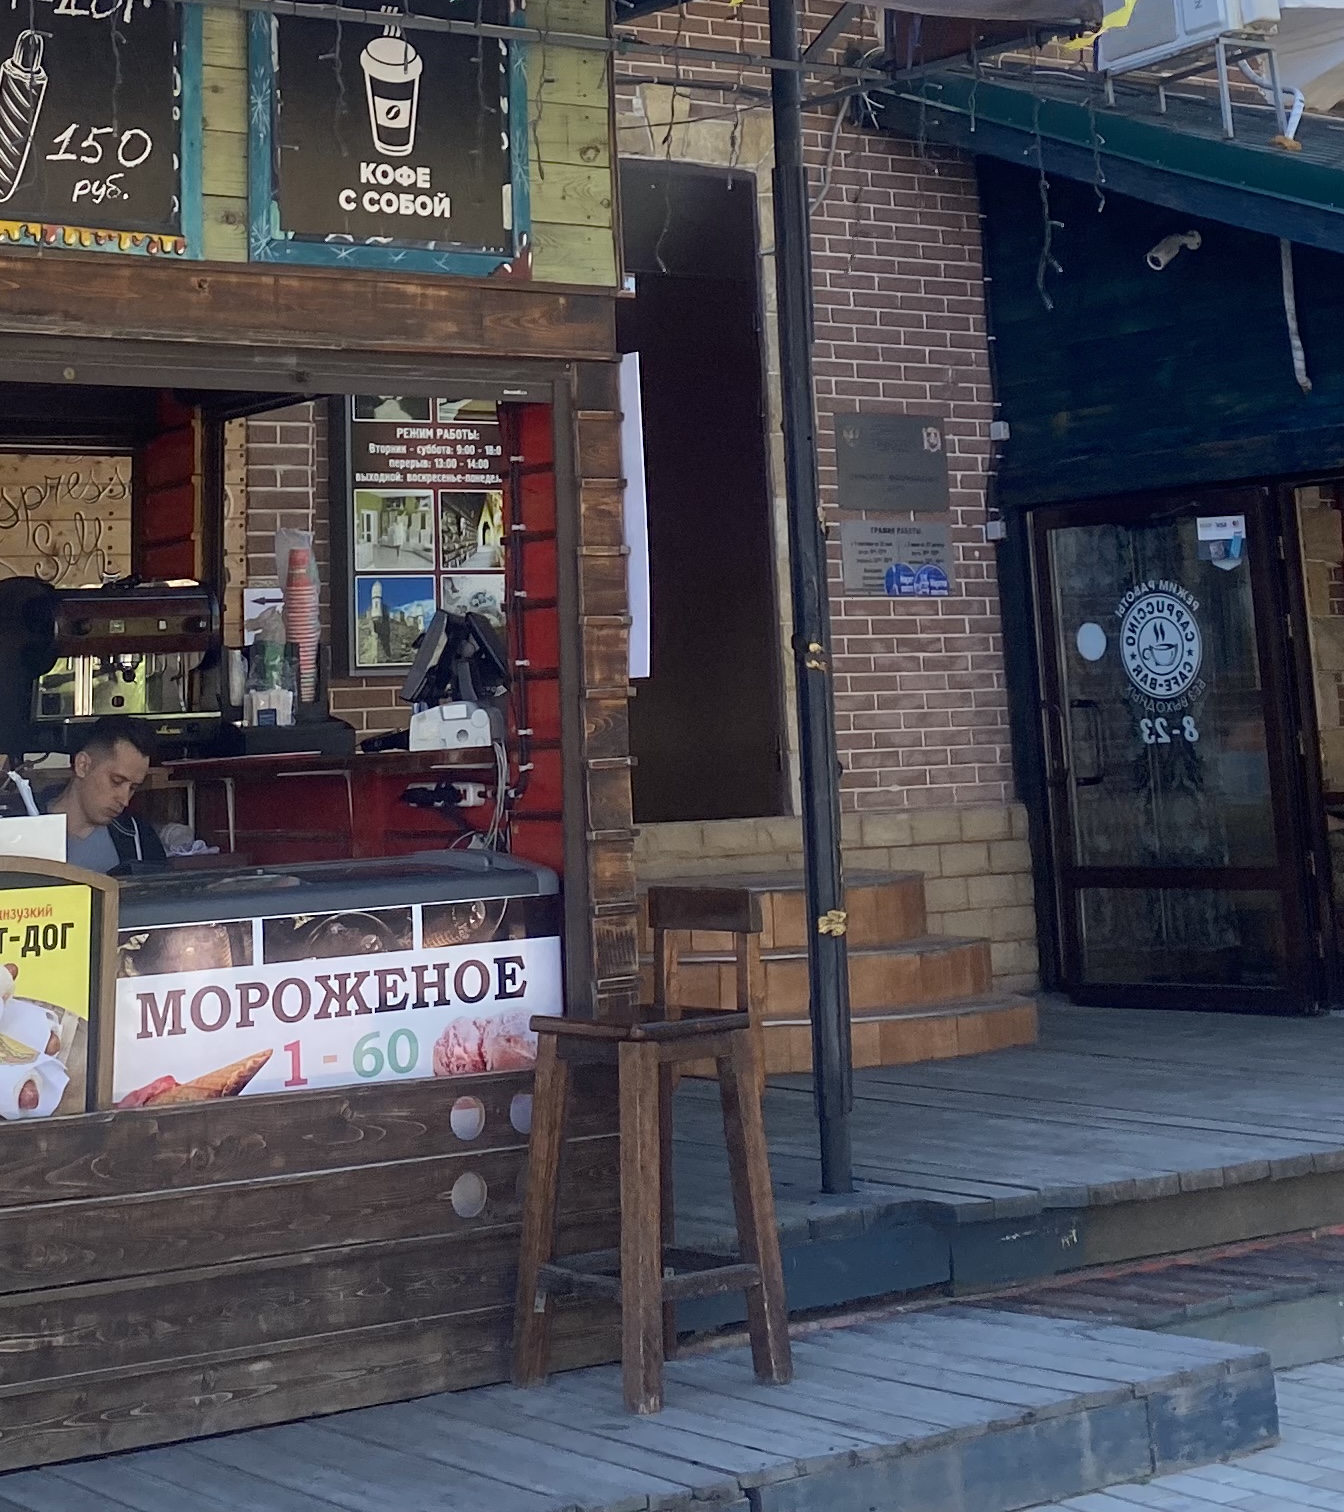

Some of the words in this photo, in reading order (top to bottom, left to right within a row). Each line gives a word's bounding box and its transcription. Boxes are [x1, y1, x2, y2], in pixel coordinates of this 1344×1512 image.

[46, 123, 153, 168] 150
[72, 172, 129, 204] руб.
[360, 162, 431, 189] КОФЕ
[338, 189, 356, 211] С
[362, 190, 451, 218] СОБОЙ
[396, 427, 433, 439] РЕЖИМ
[436, 428, 480, 440] РАБОТЫ:
[369, 443, 406, 455] Вторник
[467, 459, 489, 469] 14:00
[135, 955, 527, 1039] МОРОЖЕНОЕ
[284, 1040, 308, 1087] 1
[353, 1027, 419, 1079] 60
